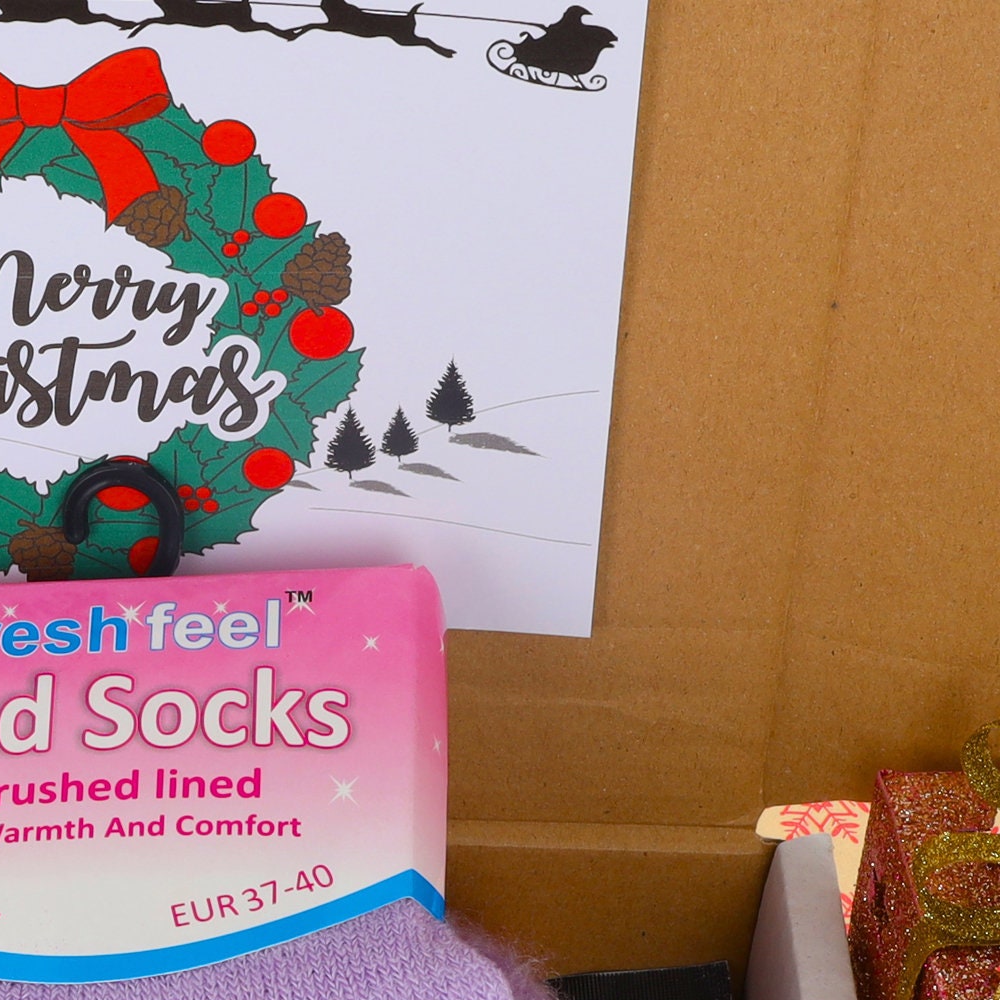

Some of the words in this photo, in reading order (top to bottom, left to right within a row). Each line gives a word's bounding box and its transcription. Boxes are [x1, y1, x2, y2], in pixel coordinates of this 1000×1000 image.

[145, 598, 282, 652] feel
[285, 590, 314, 604] TM
[81, 666, 351, 752] Socks
[155, 768, 263, 800] lined
[104, 813, 167, 838] And
[175, 813, 302, 838] Comfort
[170, 893, 237, 929] EUR
[239, 863, 335, 912] 37-40
